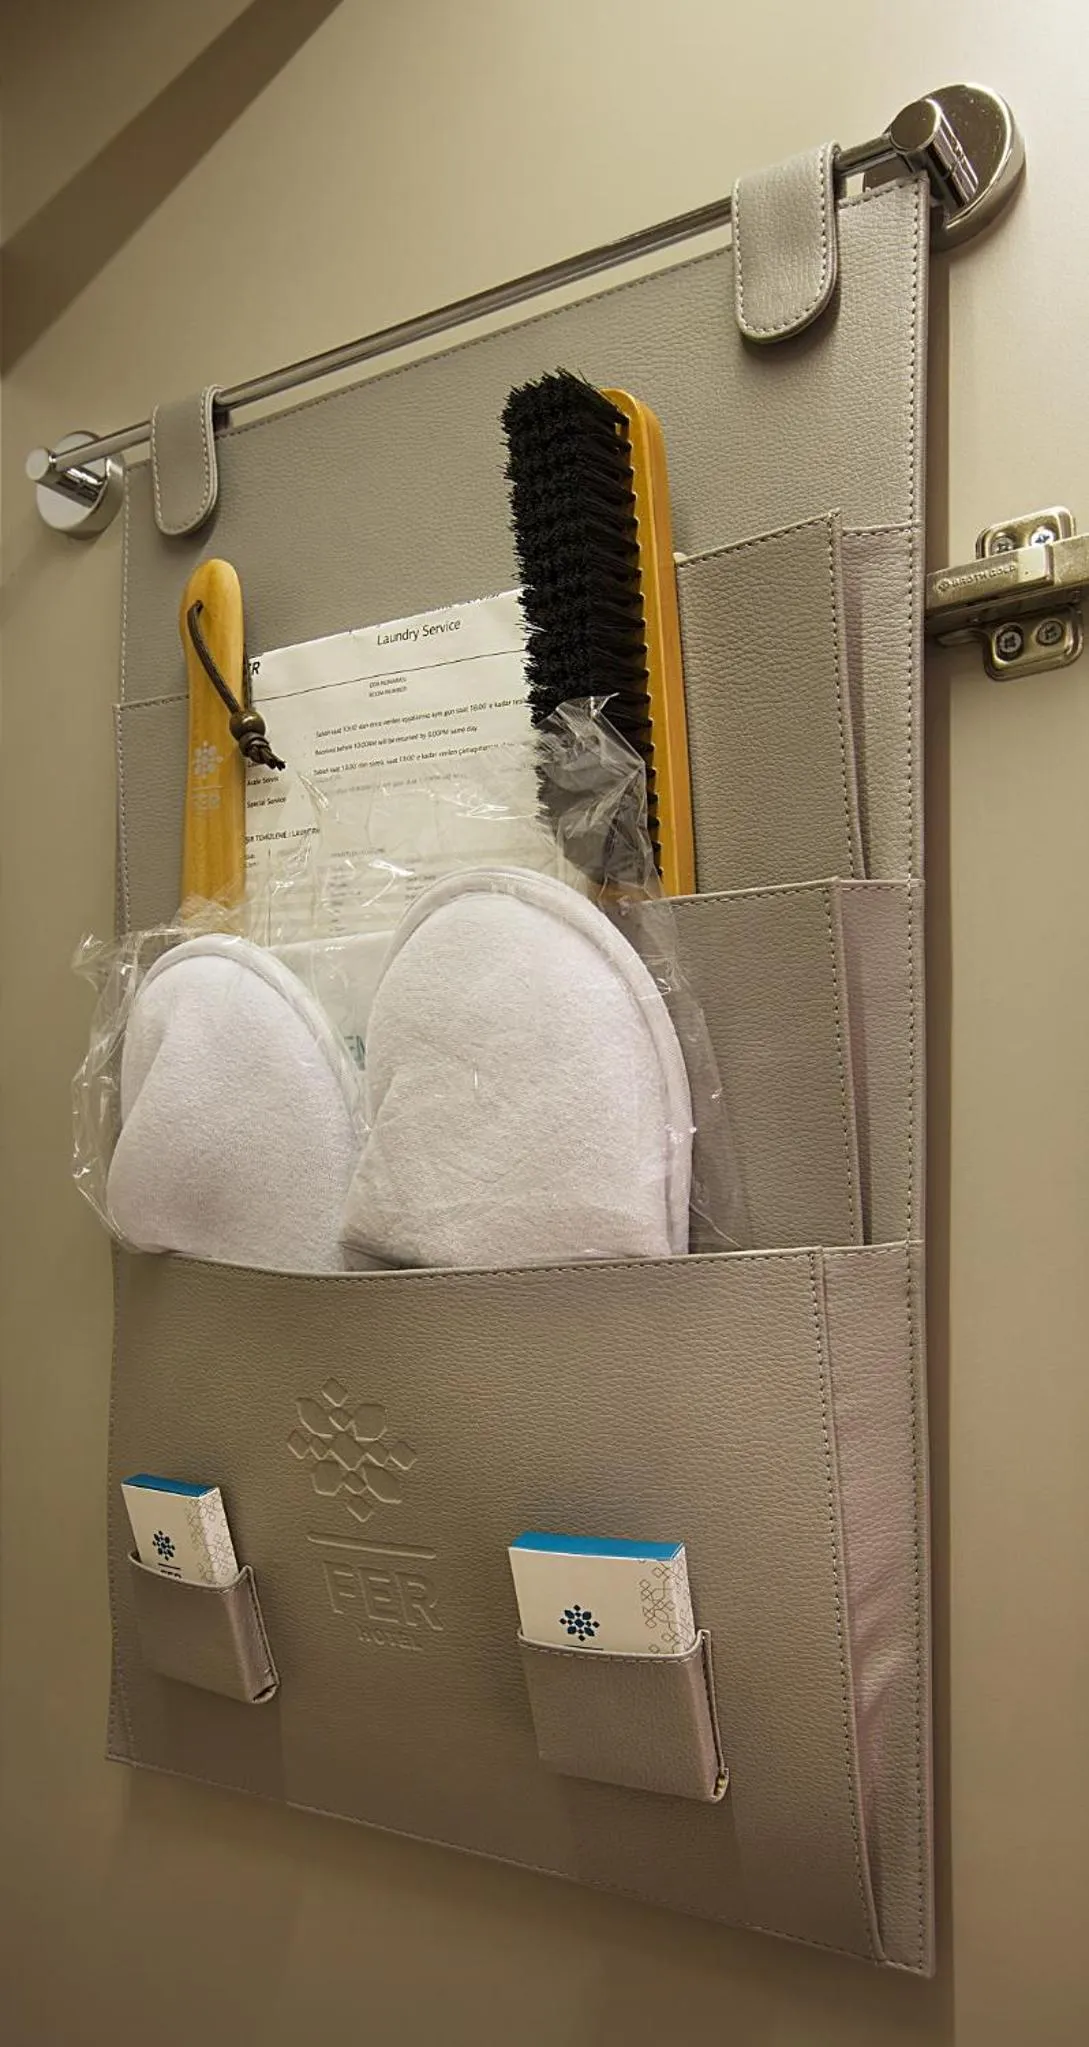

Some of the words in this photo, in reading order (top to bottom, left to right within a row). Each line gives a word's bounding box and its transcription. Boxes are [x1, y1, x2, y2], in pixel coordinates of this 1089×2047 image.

[377, 628, 419, 646] Laundry
[422, 619, 461, 637] Service
[322, 1560, 443, 1631] FER
